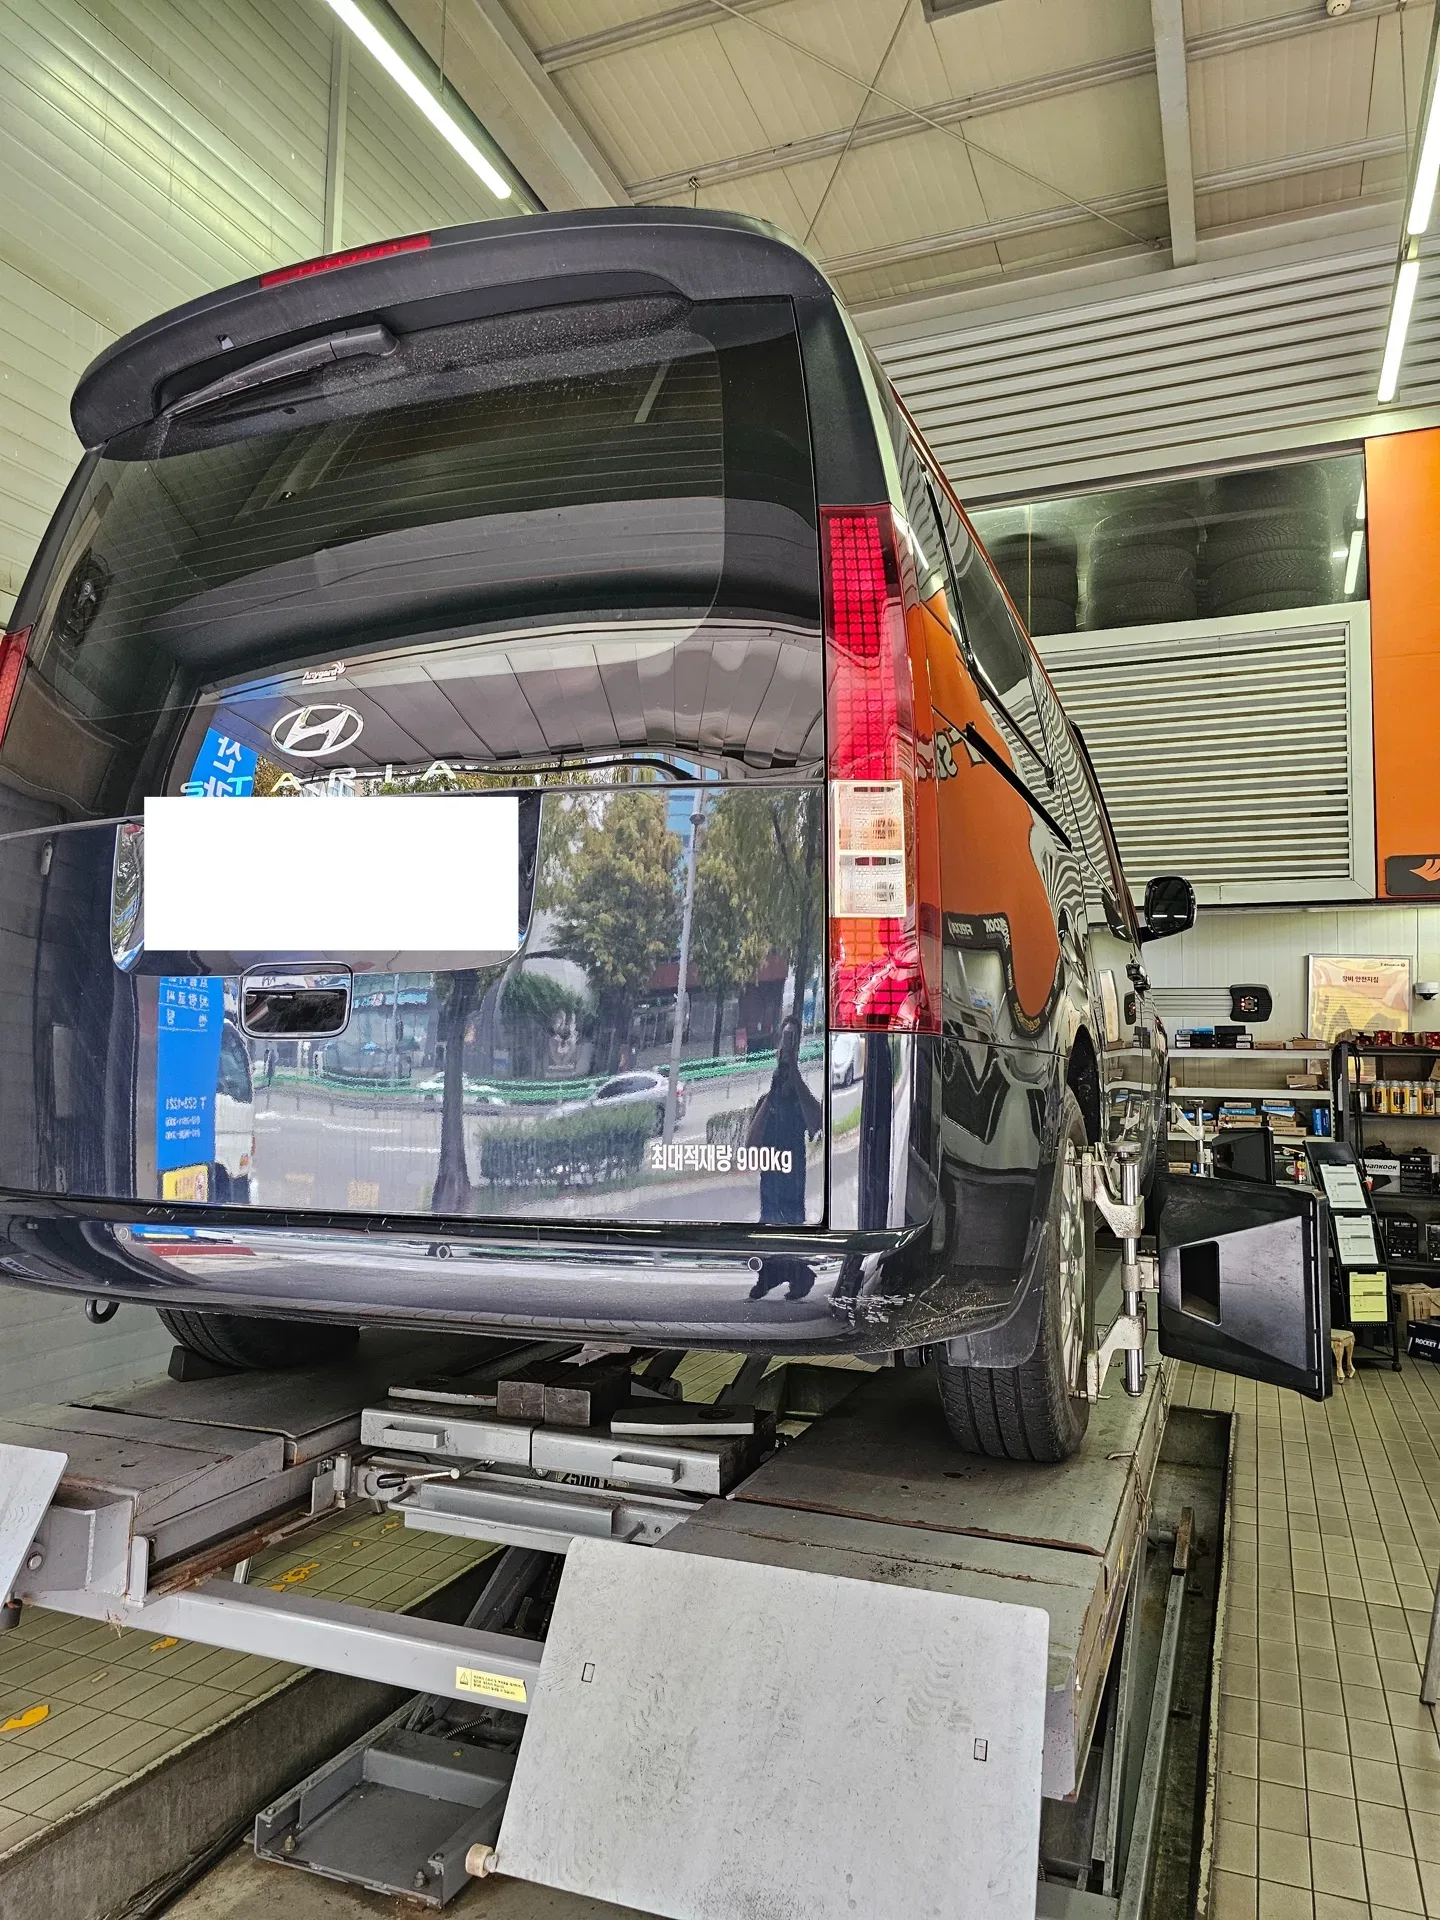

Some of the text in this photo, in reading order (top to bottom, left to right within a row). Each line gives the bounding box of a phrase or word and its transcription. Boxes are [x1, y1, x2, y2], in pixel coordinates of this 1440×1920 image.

[1342, 975, 1354, 983] 장비
[651, 1144, 793, 1174] 최대적재량 900kg
[1415, 1337, 1437, 1348] ROCKET
